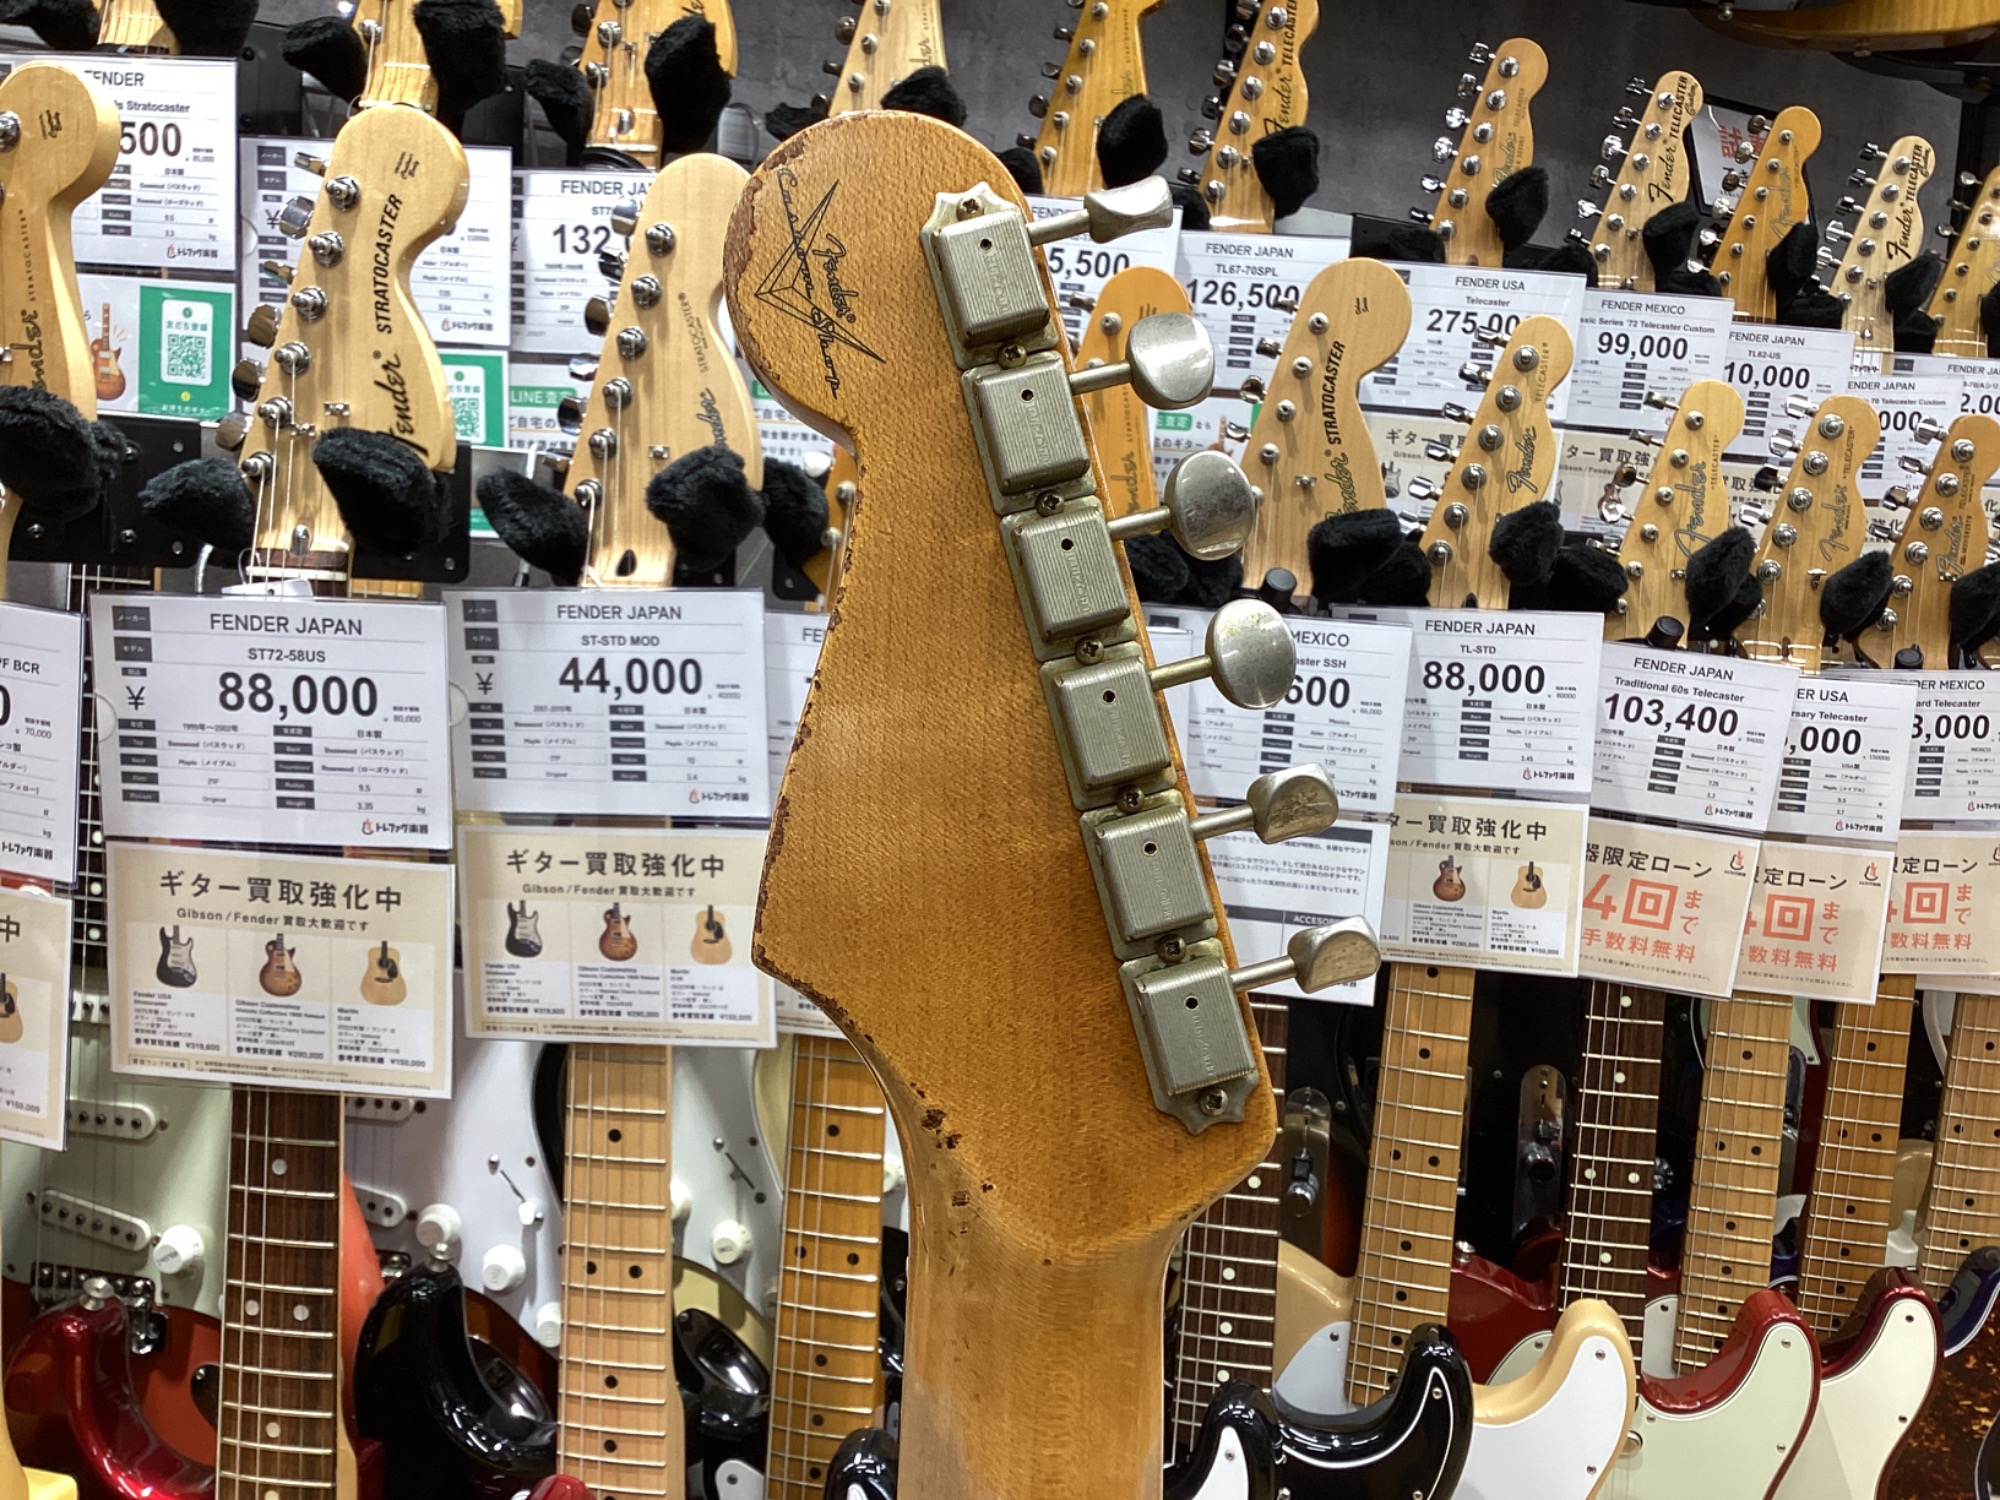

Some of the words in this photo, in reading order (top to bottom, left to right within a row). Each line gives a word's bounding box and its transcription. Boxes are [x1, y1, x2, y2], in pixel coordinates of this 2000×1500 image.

[127, 100, 191, 113] Stratocaster
[1669, 75, 1689, 145] TELECASTER
[1649, 148, 1678, 204] Fender
[1904, 144, 1923, 202] TELECASTER
[561, 180, 622, 196] FENDER
[777, 167, 814, 300] Custom
[1887, 207, 1915, 260] Fender
[20, 213, 36, 302] STRATOCASTER
[1206, 242, 1250, 257] FENDER
[1253, 245, 1294, 259] JAPAN
[375, 195, 403, 334] STRATOCASTER
[1216, 263, 1279, 277] TL67-70SPL
[813, 234, 858, 318] Fender
[1455, 276, 1498, 290] FENDER
[1501, 279, 1526, 291] USA
[1185, 279, 1300, 311] 126,500
[1466, 296, 1510, 308] Telecaster
[1601, 299, 1643, 312] FENDER
[1644, 302, 1686, 315] MEXICO
[1598, 318, 1621, 328] Series
[1640, 319, 1683, 333] Telecaster
[1684, 325, 1716, 335] Custom
[1597, 331, 1689, 360] 99,000
[1729, 332, 1770, 344] FENDER
[1771, 335, 1805, 347] JAPAN
[1724, 361, 1811, 389] 10,000
[1947, 363, 1985, 376] FENDER
[1323, 341, 1345, 445] STRATOCASTER
[1848, 381, 1881, 391] ENDER
[1883, 382, 1916, 391] JAPAN
[1507, 430, 1538, 494] Fender
[1819, 484, 1850, 562] Fender
[557, 604, 622, 621] FENDER
[626, 604, 682, 621] JAPAN
[210, 613, 290, 634] FENDER
[296, 615, 363, 636] JAPAN
[1425, 619, 1483, 635] FENDER
[1486, 622, 1536, 637] JAPAN
[581, 635, 627, 647] ST-STD
[629, 635, 660, 648] MOD
[1290, 629, 1350, 647] MEXICO
[247, 647, 327, 665] ST72-58US
[1459, 644, 1497, 655] TL-STD
[13, 658, 40, 675] BCR
[1322, 657, 1347, 669] SSH
[1633, 656, 1687, 676] FENDER
[1689, 664, 1734, 681] JAPAN
[476, 672, 493, 695] ¥
[558, 656, 702, 701] 44,000
[1422, 660, 1545, 696] 88,000
[1939, 680, 1986, 692] MEXICO
[218, 671, 378, 721] 88,000
[1614, 675, 1669, 694] Traditional
[1671, 683, 1690, 696] 60s
[1692, 686, 1745, 703] Telecaster
[1819, 690, 1850, 704] USA
[126, 686, 146, 711] ¥
[1934, 698, 1981, 710] Telecaster
[1604, 692, 1739, 737] 103,400
[1819, 711, 1869, 724] Telecaster
[25, 726, 52, 740] 70,000
[356, 729, 383, 739] 日本製
[1533, 769, 1575, 782] トレファク楽器
[701, 791, 750, 803] トレファク楽器
[1714, 806, 1754, 821] トレファク楽器
[375, 822, 429, 835] トレファク楽器
[1845, 822, 1884, 834] トレファク楽器
[506, 850, 725, 879] ギター買取強化中
[160, 870, 403, 913] ギター買取強化中
[1680, 889, 1704, 936] まで
[1954, 883, 1973, 926] まで
[1819, 901, 1841, 946] まで
[1581, 927, 1696, 966] 手数料無料
